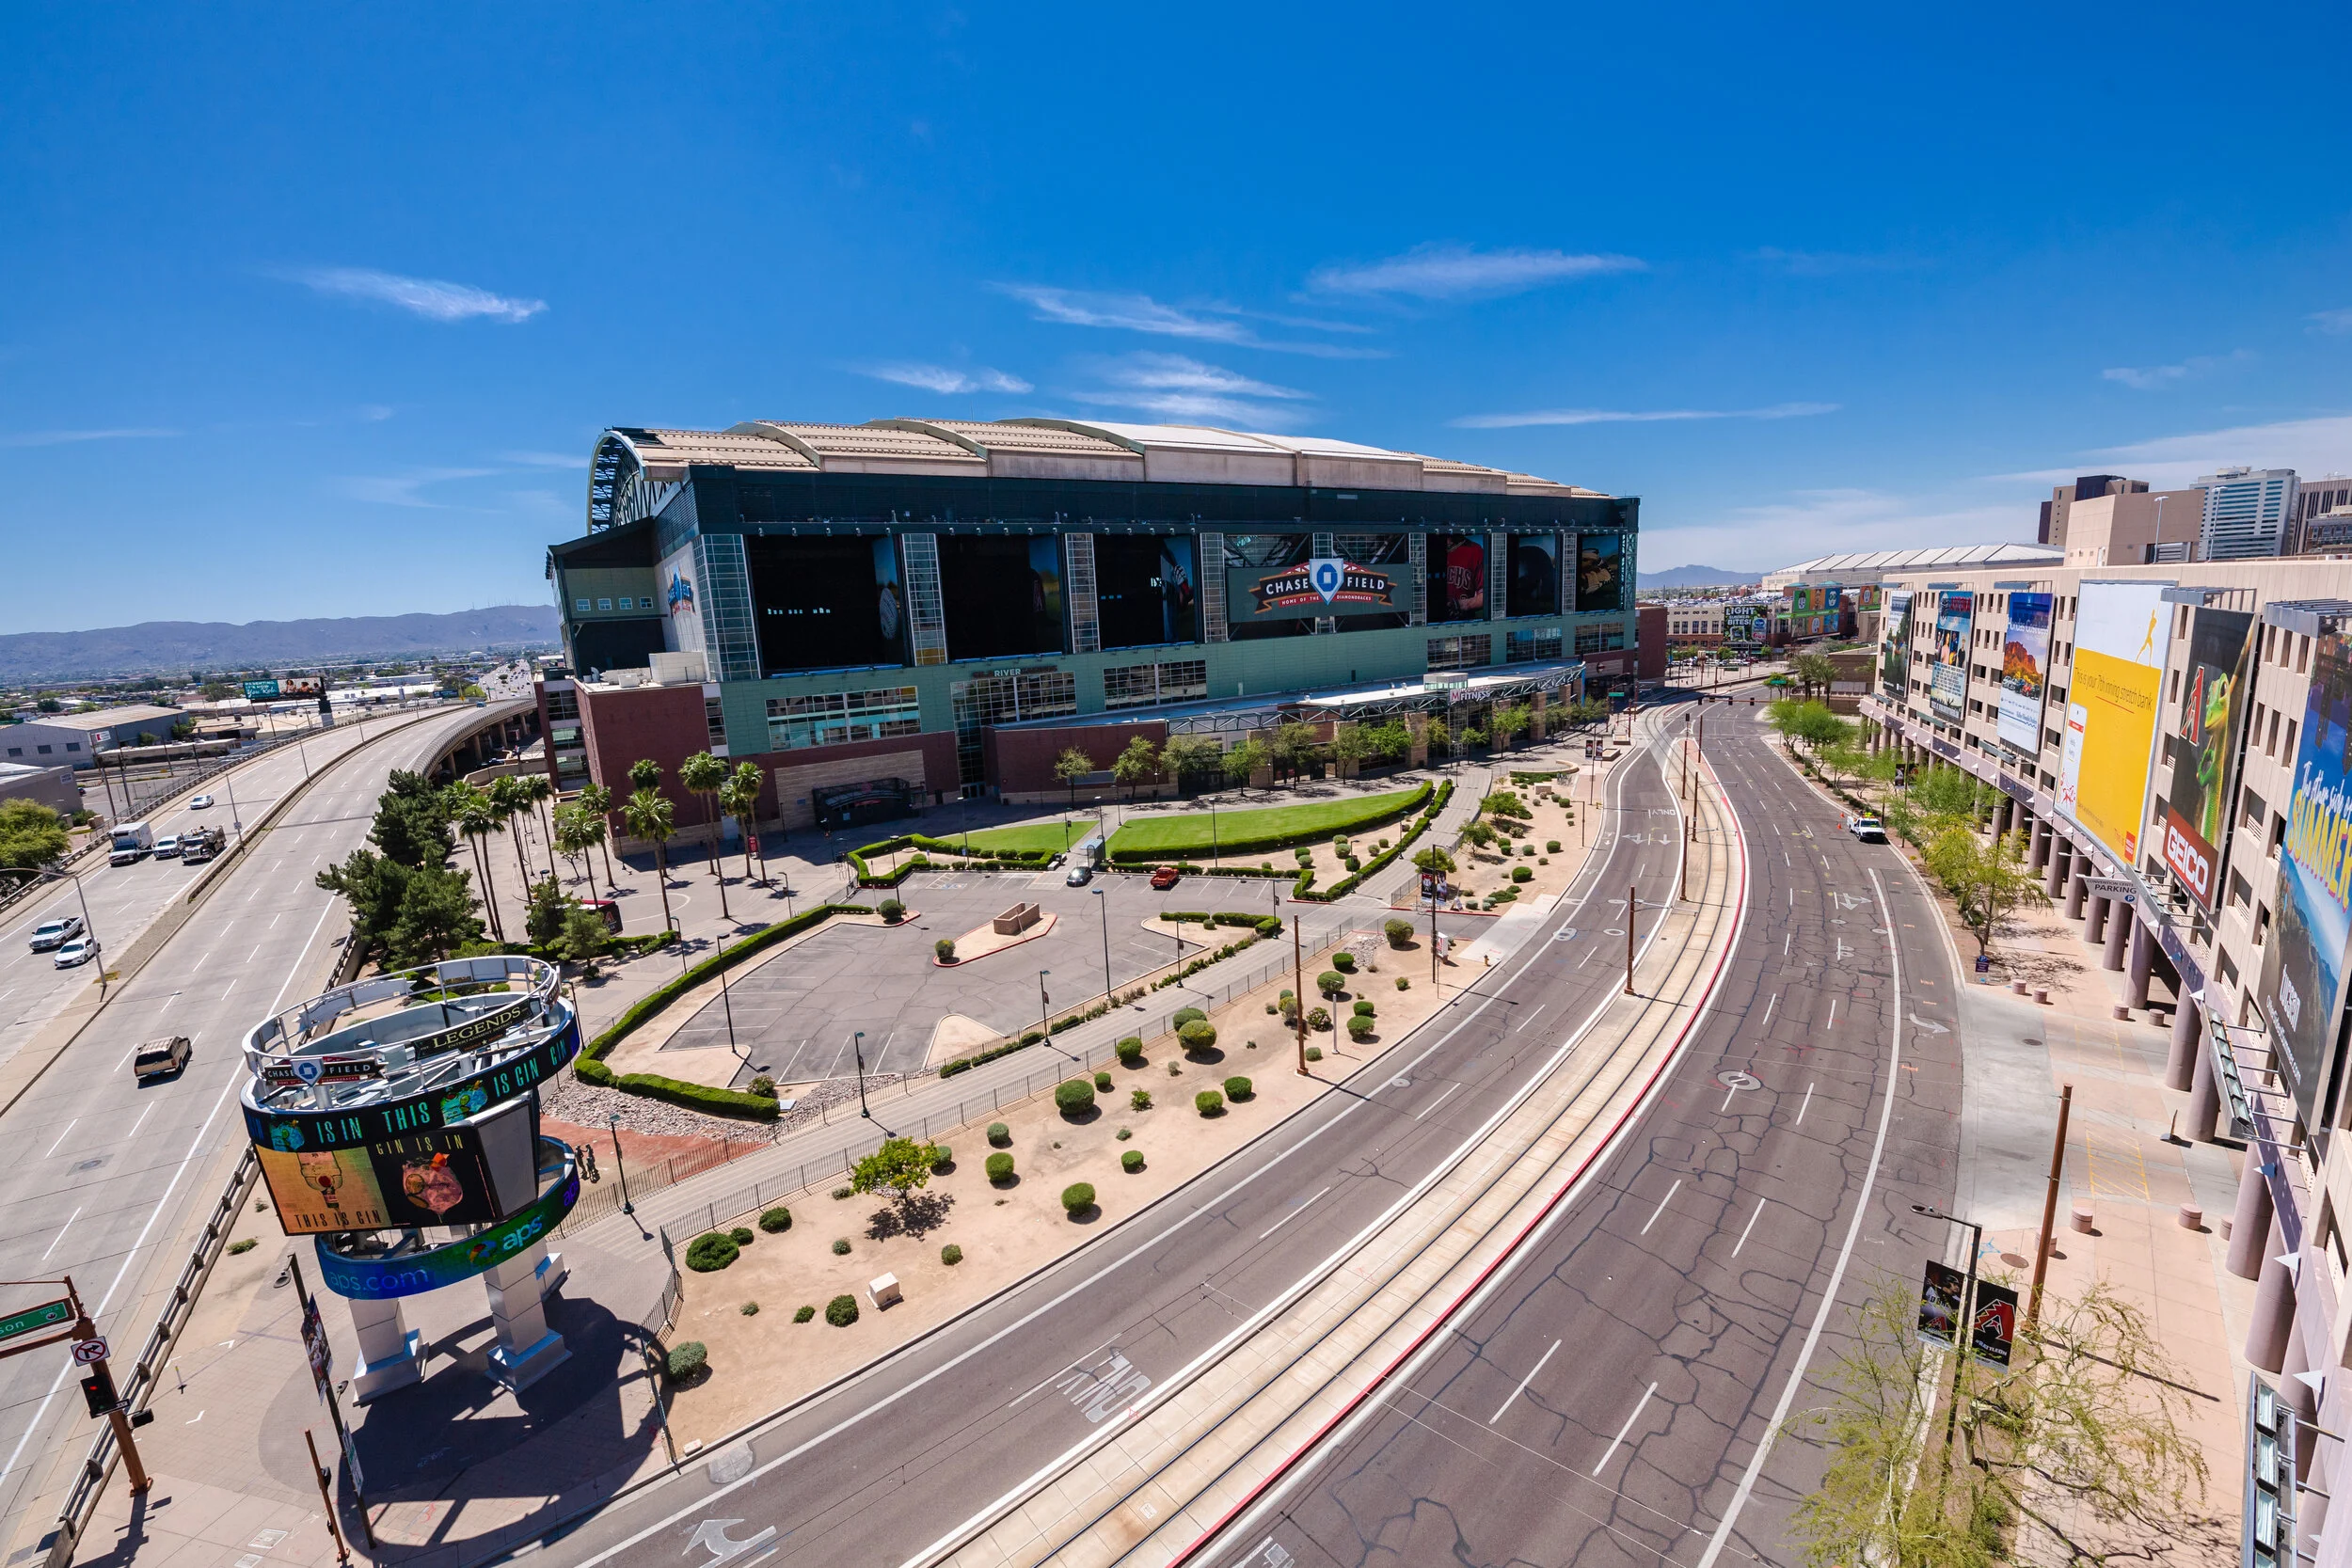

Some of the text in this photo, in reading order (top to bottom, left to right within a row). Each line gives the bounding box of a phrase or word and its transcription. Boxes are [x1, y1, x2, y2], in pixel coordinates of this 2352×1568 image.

[1266, 577, 1385, 594] CHASE FIELD
[1725, 607, 1755, 615] LIGHT
[993, 668, 1021, 677] RIVER
[1460, 691, 1491, 701] FITNESS
[2074, 667, 2083, 684] This
[2086, 675, 2097, 690] your
[2121, 687, 2137, 705] stretch
[2137, 689, 2153, 711] bank
[2301, 760, 2312, 798] The
[2326, 779, 2344, 817] side
[2167, 825, 2209, 895] GEICO
[2287, 788, 2352, 913] SUMMER
[2094, 883, 2137, 894] PARKING
[433, 1006, 521, 1048] LEGENDS
[448, 1030, 492, 1049] ENTERTAINMENT
[549, 1038, 566, 1066] GIN
[329, 1064, 371, 1074] FIELD
[315, 1120, 334, 1144] IS
[342, 1117, 362, 1140] IN
[382, 1102, 429, 1133] THIS
[492, 1076, 510, 1098] IS
[515, 1057, 539, 1087] GIN
[376, 1134, 464, 1156] GIN IS IN
[294, 1209, 381, 1228] THIS IS GIN
[501, 1216, 543, 1252] aps
[329, 1268, 429, 1292] aps.com
[40, 1307, 53, 1316] 100
[1056, 1351, 1152, 1423] ONLY
